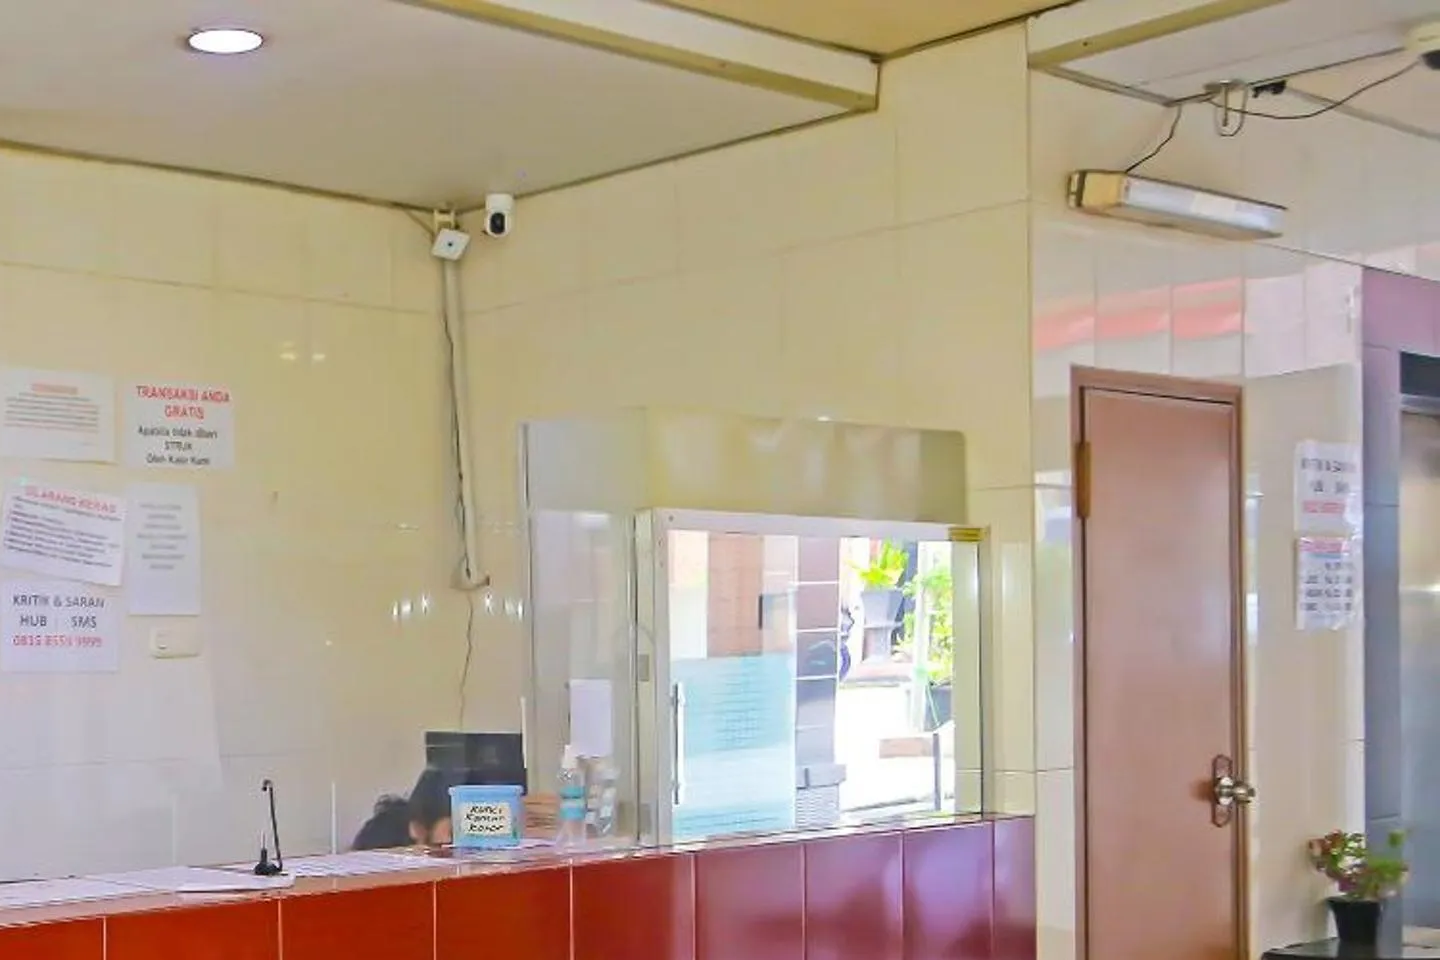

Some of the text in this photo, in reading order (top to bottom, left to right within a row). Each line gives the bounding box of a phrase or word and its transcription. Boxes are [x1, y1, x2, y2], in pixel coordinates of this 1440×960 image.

[136, 386, 229, 402] TRANSAKSI ANDA
[165, 404, 204, 420] GRATIS
[13, 594, 49, 606] KRITIK
[65, 597, 105, 608] SARAN
[20, 615, 97, 629] HUB SMS
